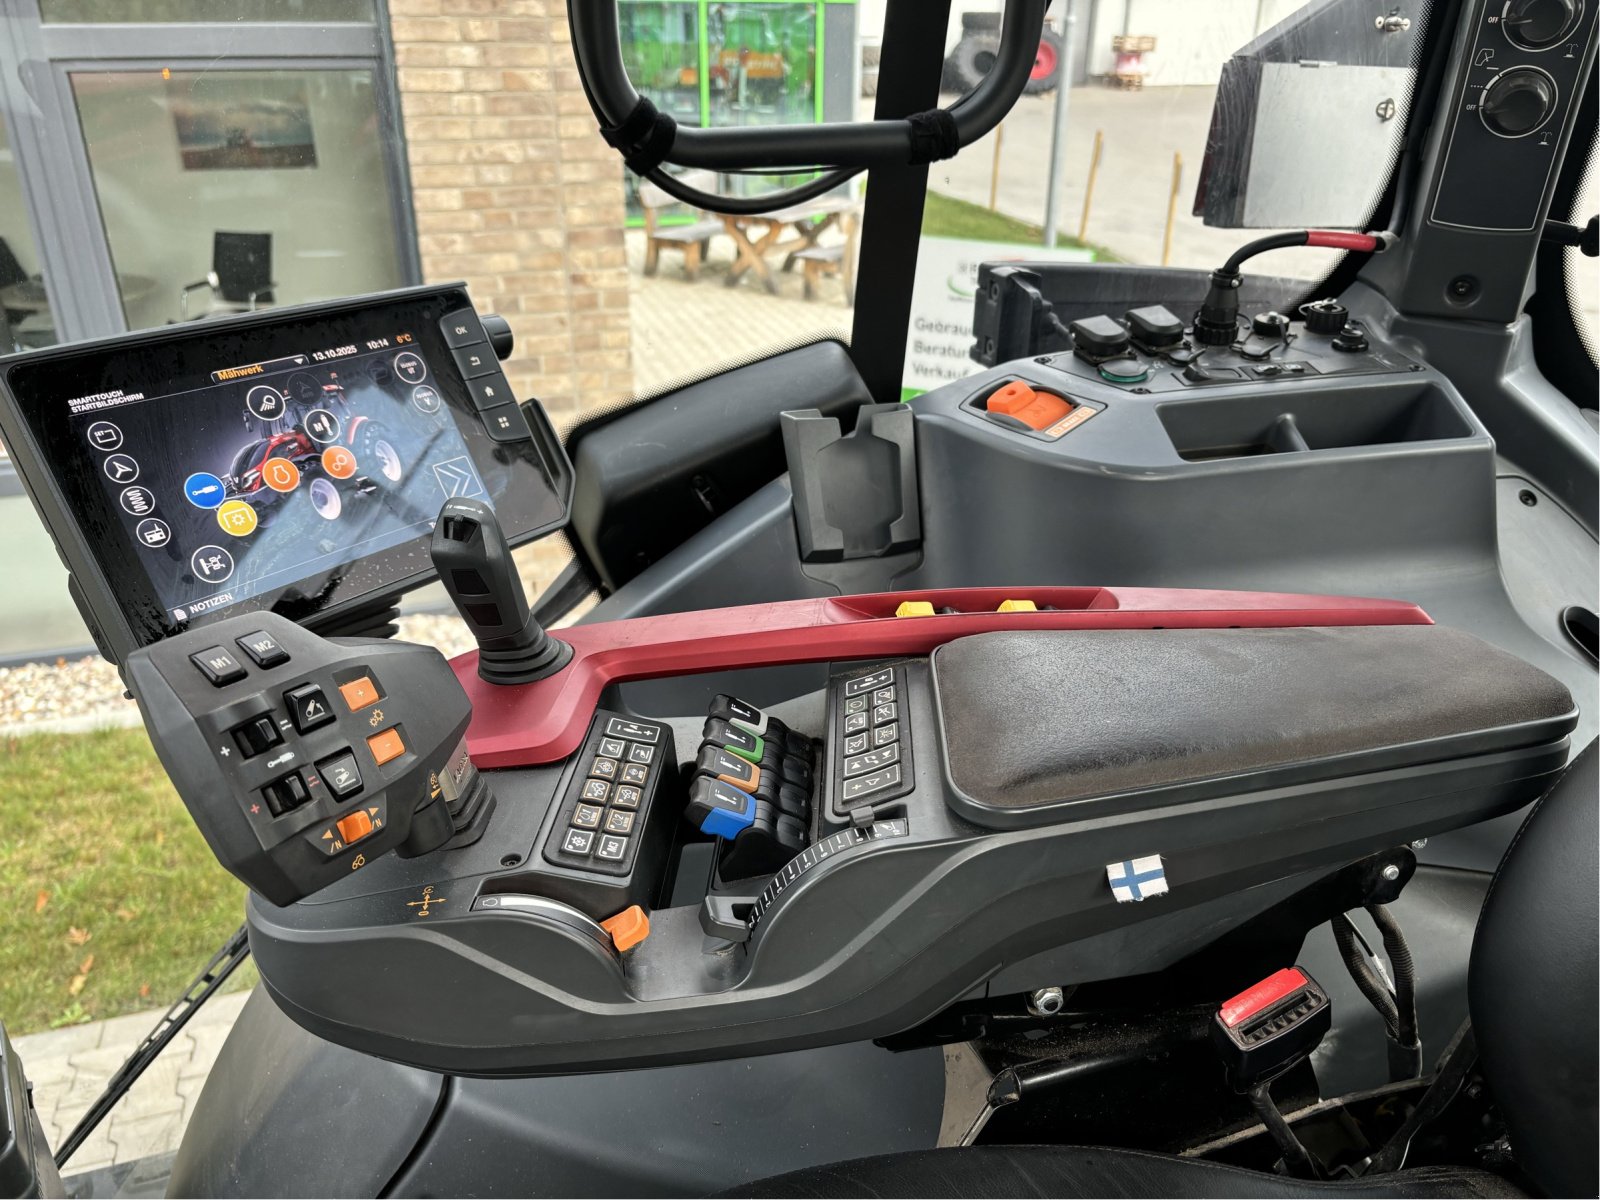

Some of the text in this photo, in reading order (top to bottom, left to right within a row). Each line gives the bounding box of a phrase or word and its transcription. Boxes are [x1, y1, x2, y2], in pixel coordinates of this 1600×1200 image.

[1488, 16, 1499, 24] OFF
[455, 326, 468, 335] OK
[312, 333, 413, 361] 13.10.2025 10:14 6°C
[217, 363, 264, 381] Mähwerk
[67, 389, 124, 407] SMARTTOUCH
[70, 392, 145, 413] STARTBILDSCHIRM
[313, 422, 324, 432] M
[189, 593, 233, 614] NOTIZEN
[253, 640, 275, 652] M2
[210, 656, 231, 669] M1
[606, 841, 619, 853] M3
